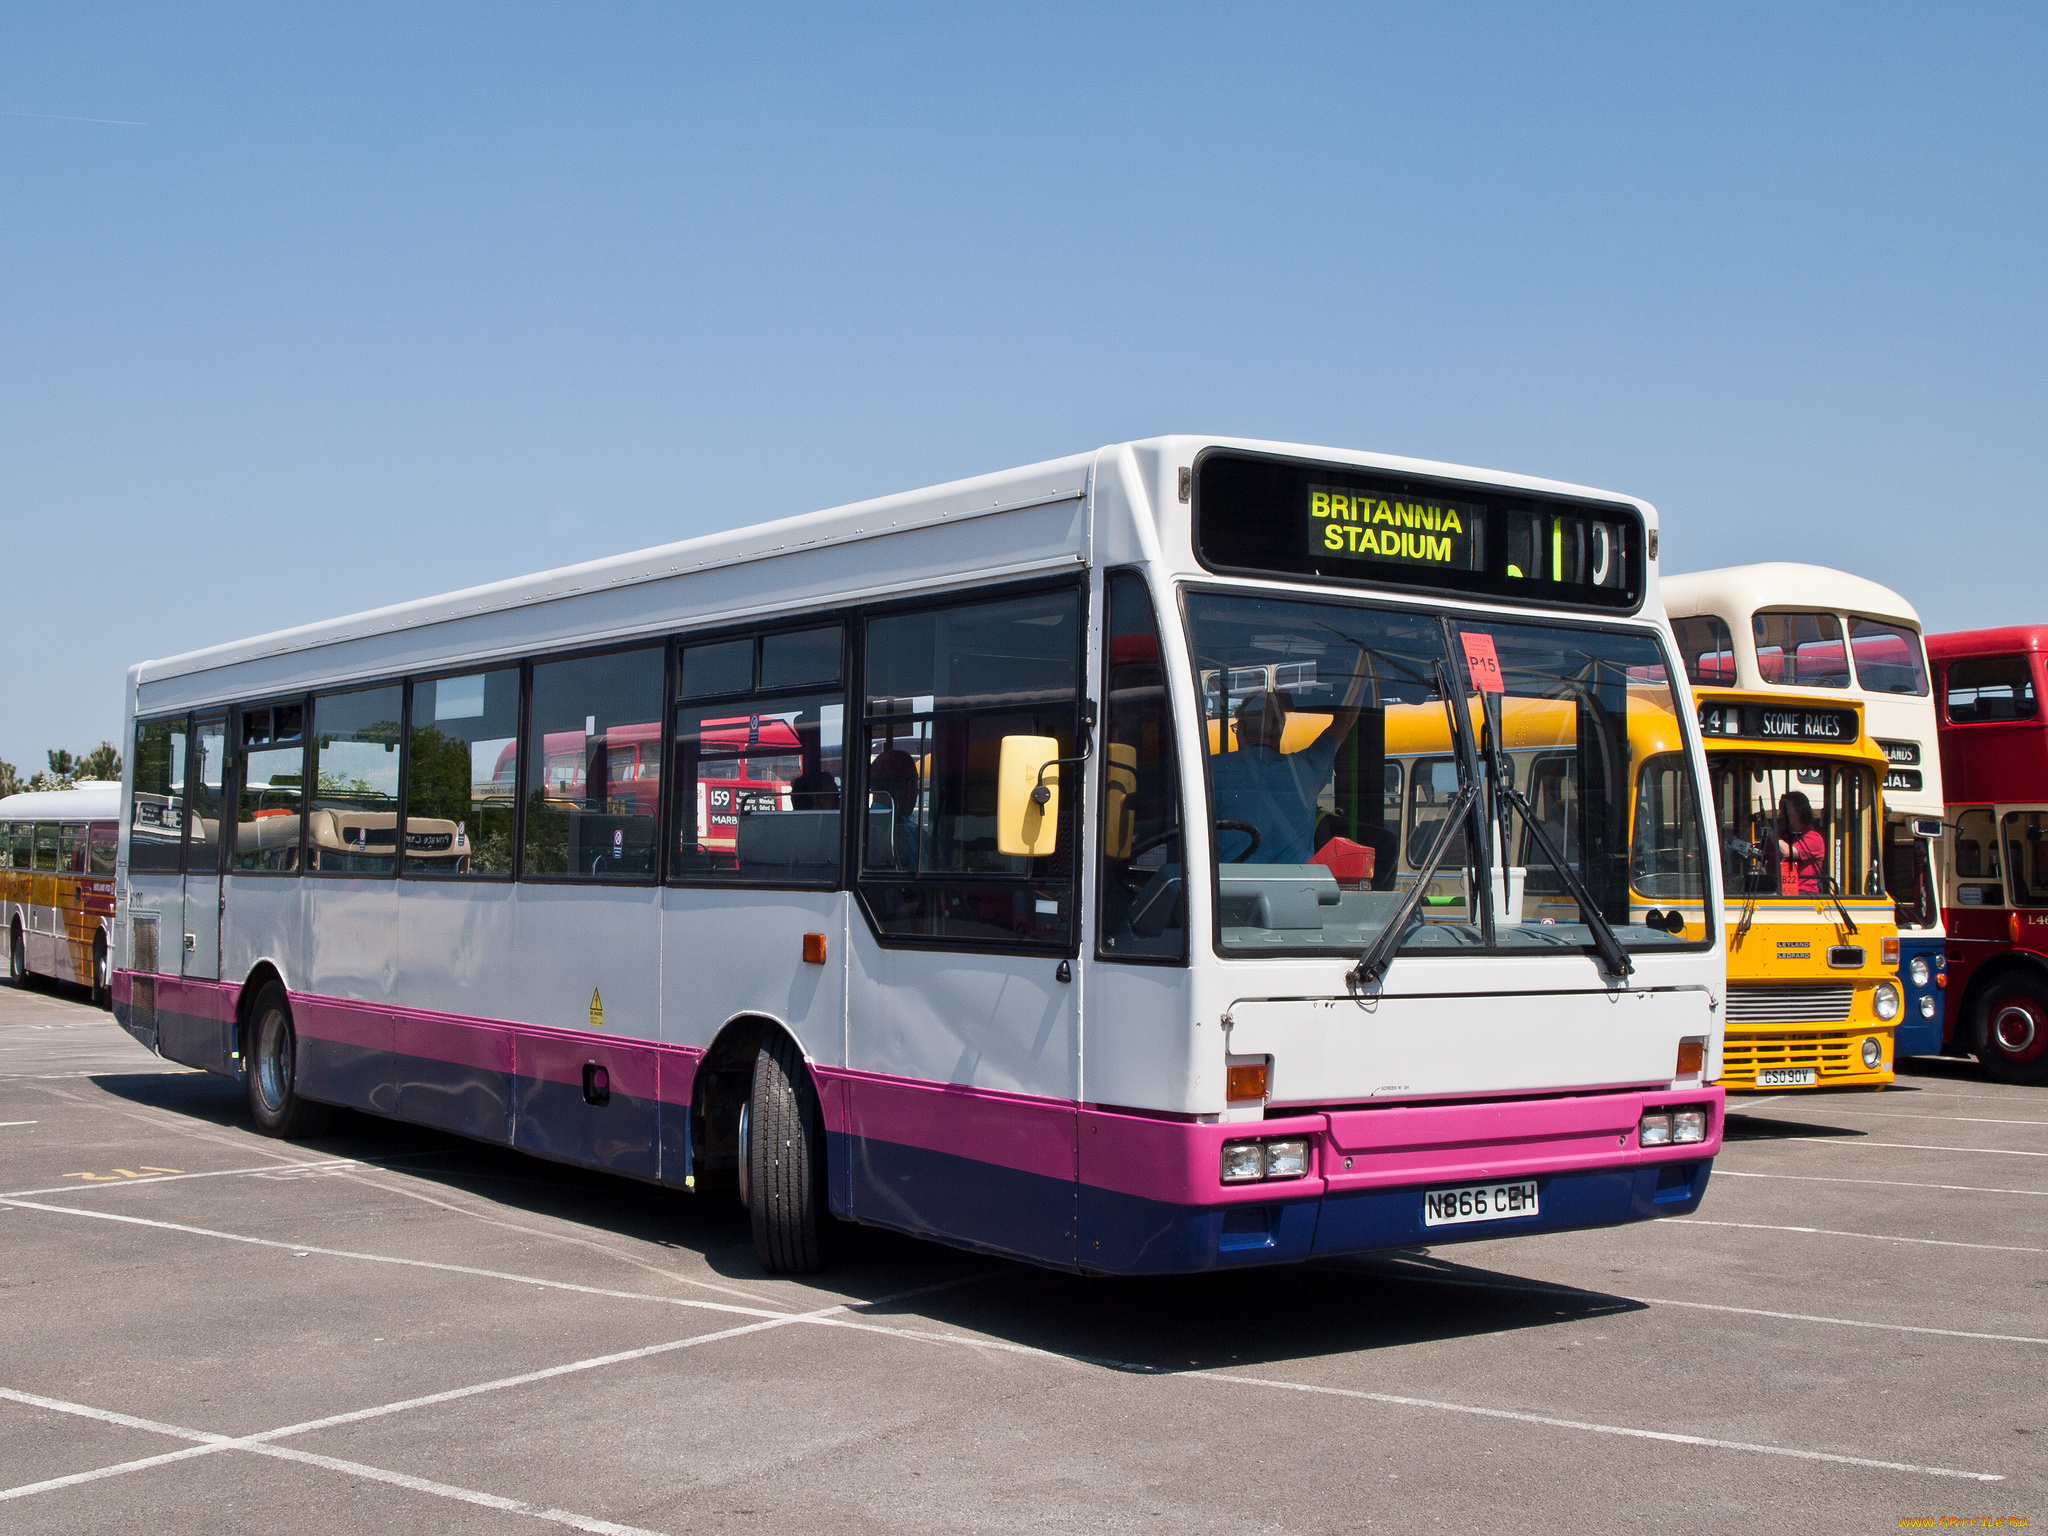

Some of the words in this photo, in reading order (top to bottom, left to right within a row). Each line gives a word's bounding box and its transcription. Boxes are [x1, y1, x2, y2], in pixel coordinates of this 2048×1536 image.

[1312, 492, 1463, 534] BRITANNIA
[1324, 524, 1452, 562] STADIUM
[1469, 656, 1496, 672] P15
[1763, 712, 1799, 735] SCONE
[1804, 713, 1840, 736] RACES
[711, 791, 730, 805] 159
[1782, 875, 1797, 884] B22
[1428, 1189, 1488, 1219] N866
[1494, 1184, 1535, 1212] CEH
